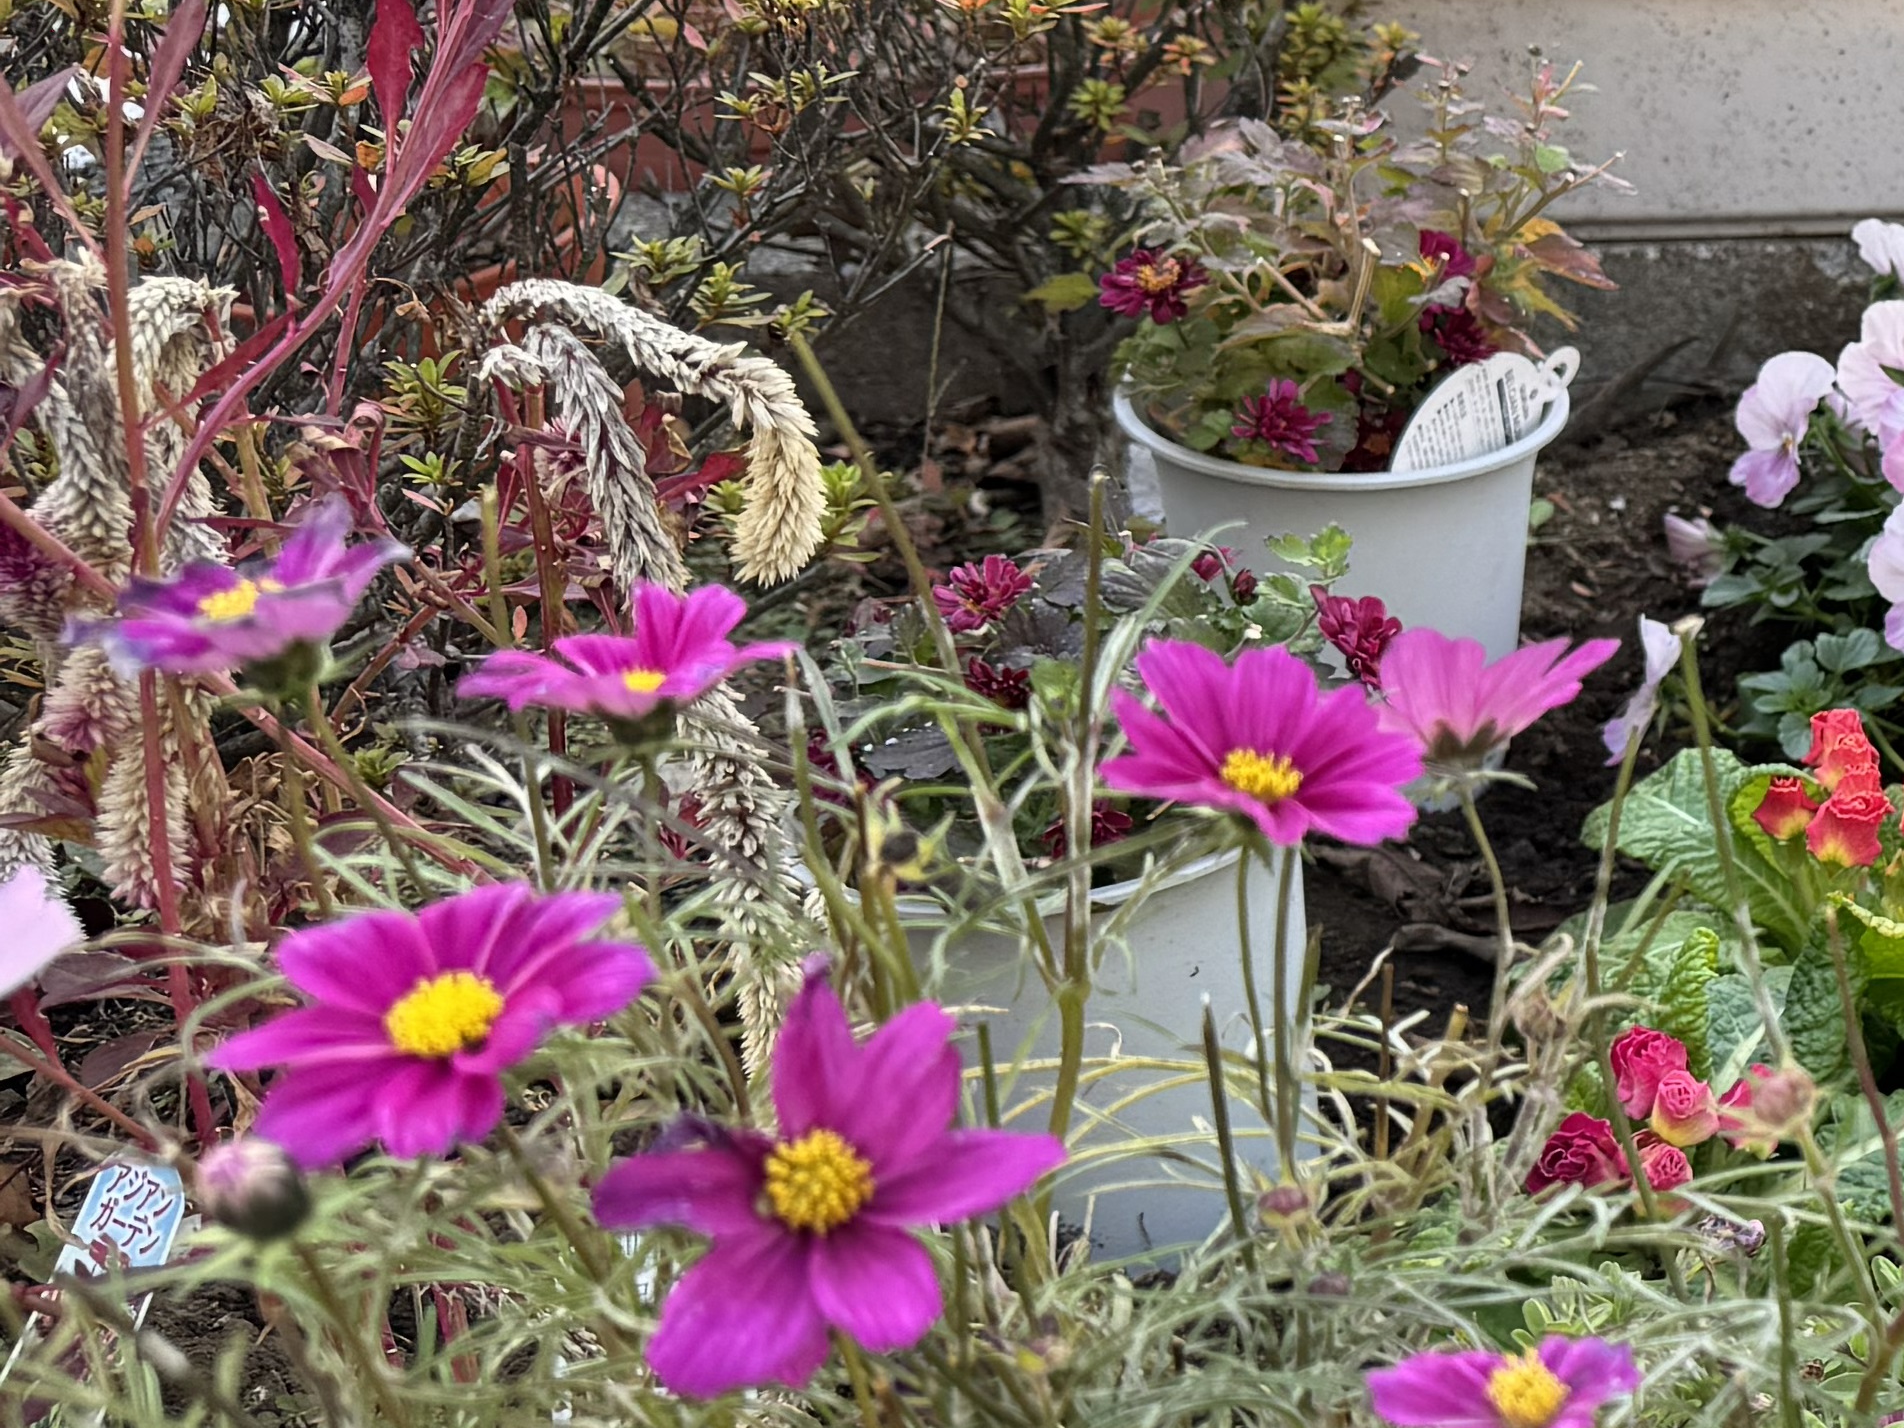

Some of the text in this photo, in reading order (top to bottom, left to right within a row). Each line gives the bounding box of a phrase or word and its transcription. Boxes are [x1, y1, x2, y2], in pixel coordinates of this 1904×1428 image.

[106, 1163, 175, 1219] アジアン
[90, 1197, 160, 1254] ガーデン
